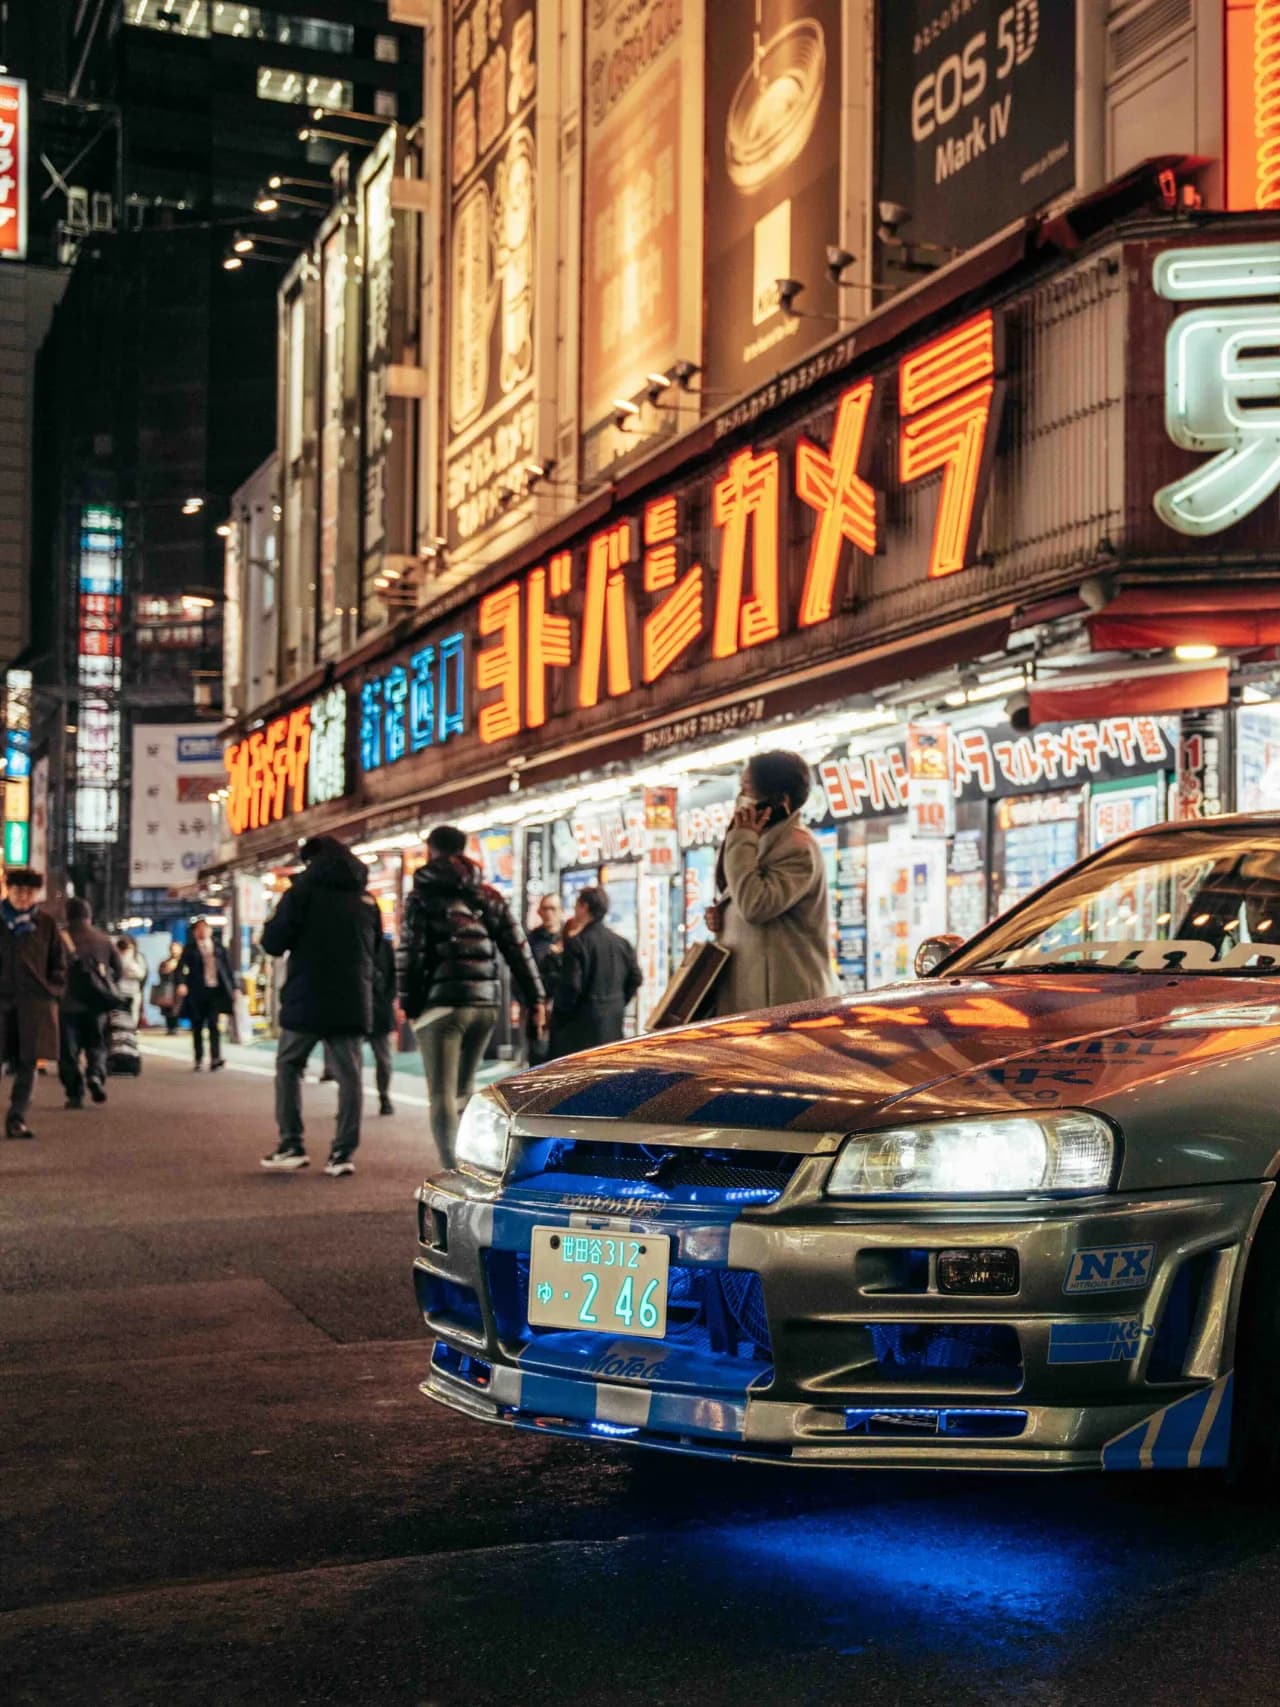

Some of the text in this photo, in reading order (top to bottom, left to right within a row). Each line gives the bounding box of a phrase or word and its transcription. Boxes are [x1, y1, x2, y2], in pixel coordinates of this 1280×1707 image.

[912, 30, 987, 142] EOS
[996, 0, 1040, 79] 5D
[935, 115, 987, 184] Mark
[477, 308, 995, 746] ヨドバシカメラ
[993, 716, 1167, 785] マルチメディア館
[1075, 1249, 1151, 1281] NX
